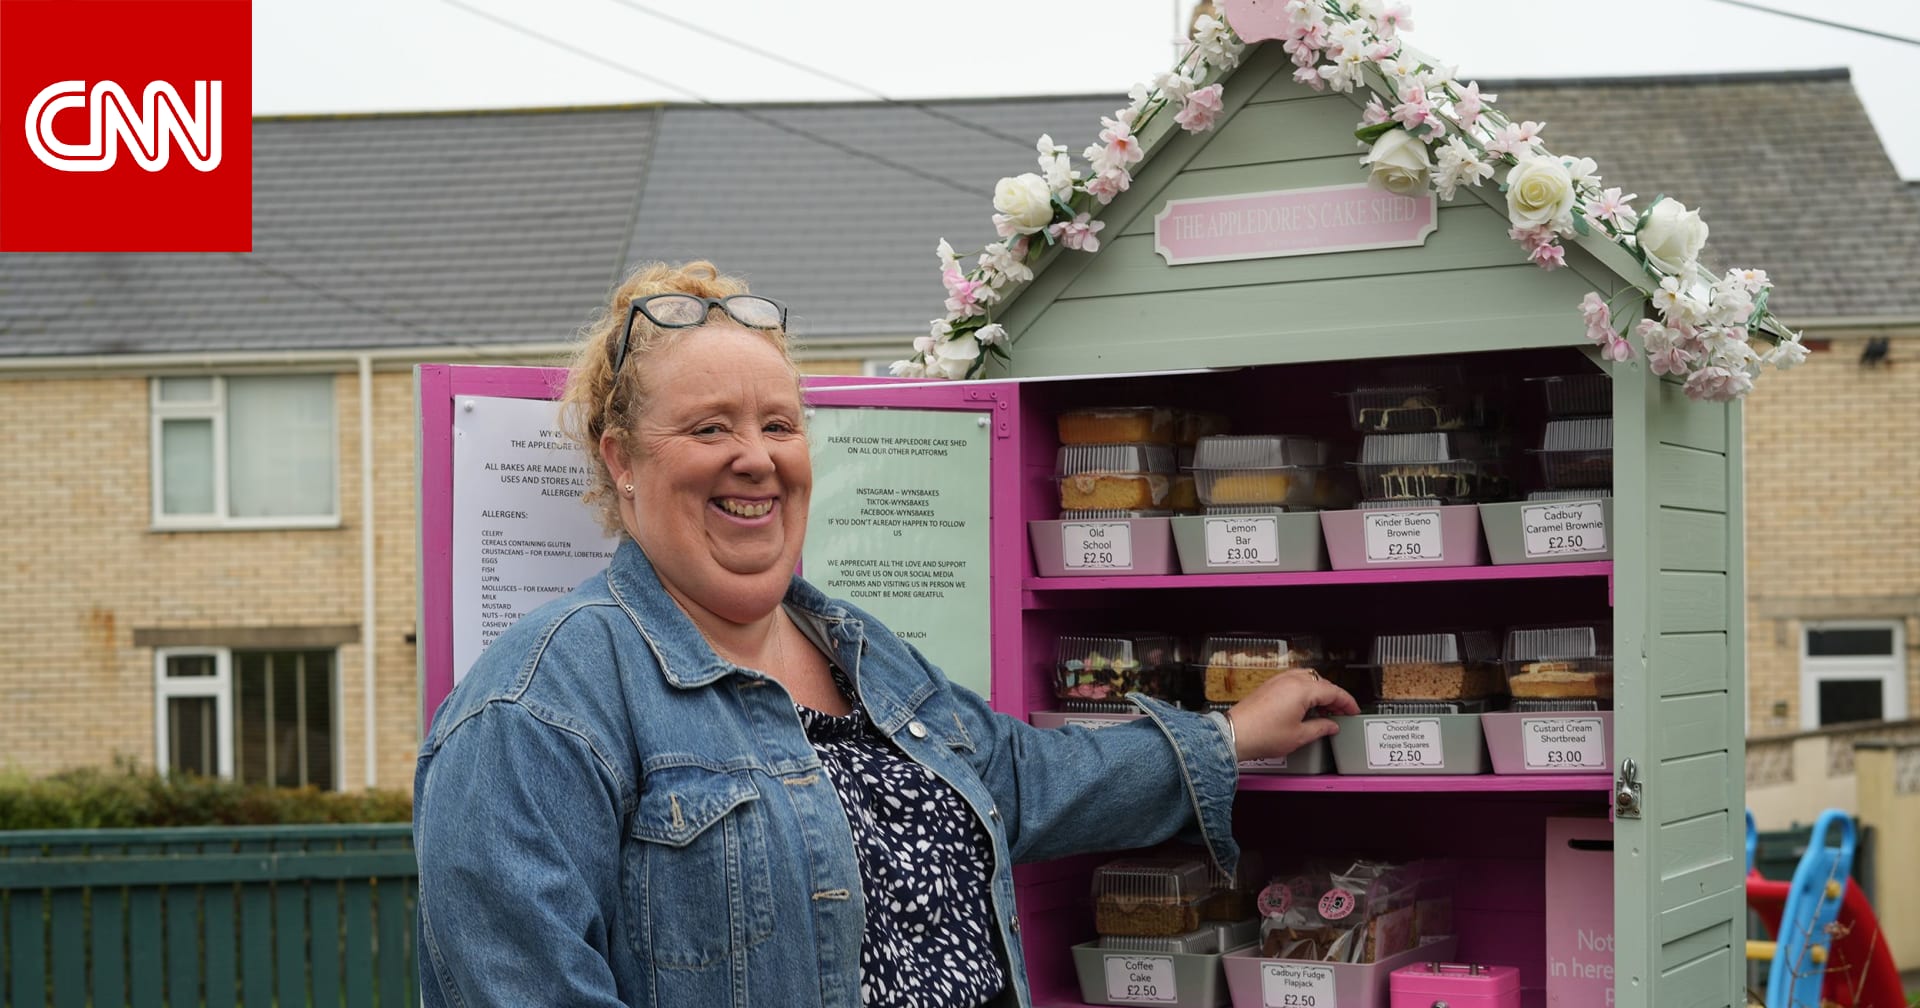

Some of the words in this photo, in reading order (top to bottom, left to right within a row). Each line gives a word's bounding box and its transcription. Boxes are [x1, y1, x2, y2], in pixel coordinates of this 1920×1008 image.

[1174, 215, 1202, 241] THE
[1207, 204, 1316, 238] APPLEDORE'S
[1320, 200, 1367, 227] CAKE
[1371, 196, 1416, 224] SHED
[528, 441, 572, 450] APPLEDORE
[482, 510, 528, 518] ALLERGENS:
[1544, 510, 1582, 521] Cadbury
[1375, 517, 1402, 527] Kinder
[1405, 517, 1430, 526] Bueno
[1526, 523, 1563, 534] Caramel
[1566, 520, 1603, 531] Brownie
[1090, 528, 1104, 538] Old
[1226, 524, 1256, 533] Lemon
[1387, 528, 1420, 537] Brownie
[1083, 541, 1111, 549] School
[1236, 536, 1251, 545] Bar
[1549, 536, 1582, 548] £2.50
[1228, 549, 1258, 560] £3.00
[1389, 544, 1420, 555] £2.50
[1084, 553, 1112, 563] £2.50
[1541, 734, 1585, 743] Shortbread
[1389, 751, 1421, 762] £2.50
[1548, 751, 1581, 762] £3.00
[1126, 961, 1154, 970] Coffee
[1551, 958, 1566, 977] in
[1130, 973, 1151, 982] Cake
[1271, 969, 1300, 979] Cadbury
[1303, 970, 1325, 980] Fudge
[1284, 978, 1313, 988] Flapjack
[1127, 985, 1156, 996] £2.50
[1284, 994, 1315, 1007] £2.50
